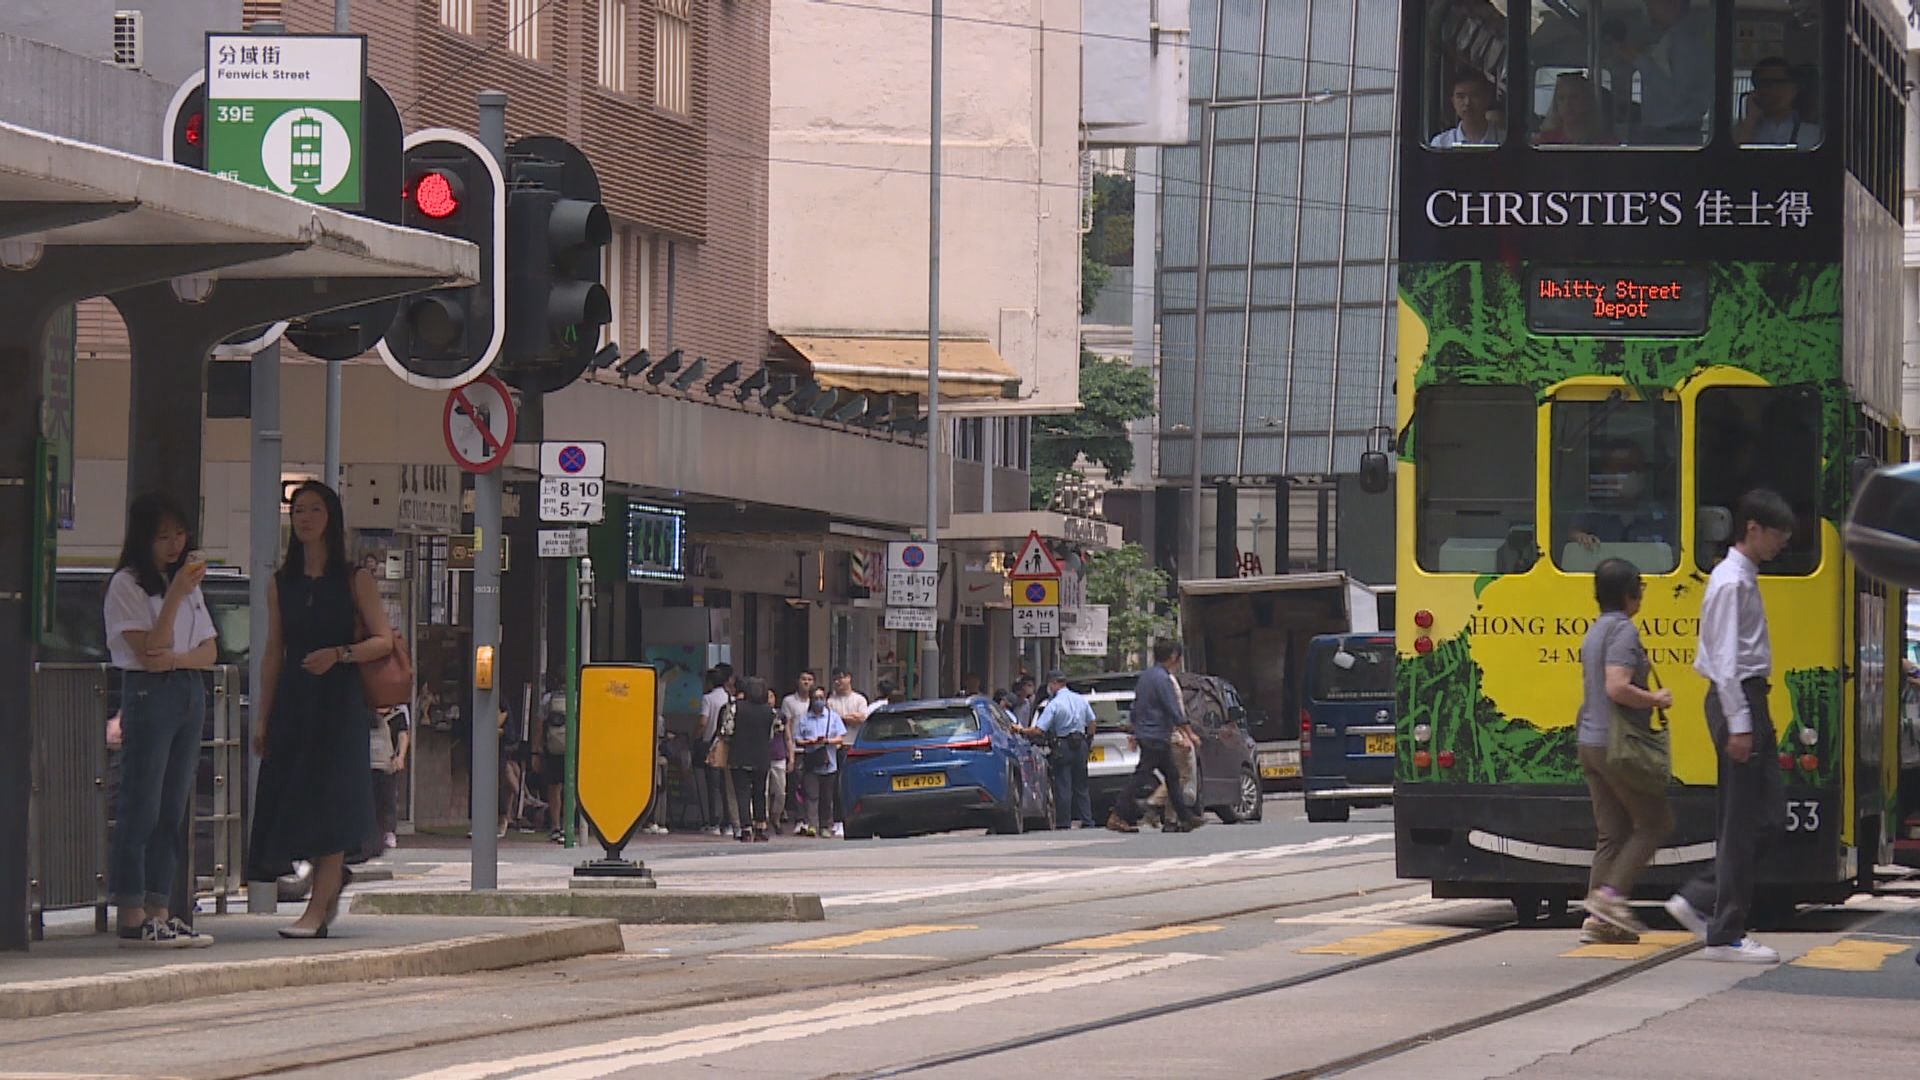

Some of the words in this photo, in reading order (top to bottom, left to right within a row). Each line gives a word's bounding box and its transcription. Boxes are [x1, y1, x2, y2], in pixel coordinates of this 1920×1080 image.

[218, 44, 281, 65] 分域街
[217, 68, 269, 80] Fenwick
[272, 69, 310, 80] Street
[217, 105, 255, 122] 39E
[1426, 189, 1682, 227] CHRISTIE'S
[1694, 189, 1815, 227] 佳士得
[1539, 279, 1606, 302] Whitty
[1615, 279, 1682, 299] Street
[1593, 300, 1649, 319] Depot
[1018, 609, 1034, 619] 24
[1036, 609, 1055, 619] hrs
[1022, 622, 1050, 635] 全日
[1471, 617, 1545, 636] HONG
[1556, 617, 1597, 636] KO
[1638, 617, 1701, 637] AUCT
[1539, 648, 1561, 664] 24
[913, 775, 942, 786] 4703
[1785, 801, 1820, 832] 53
